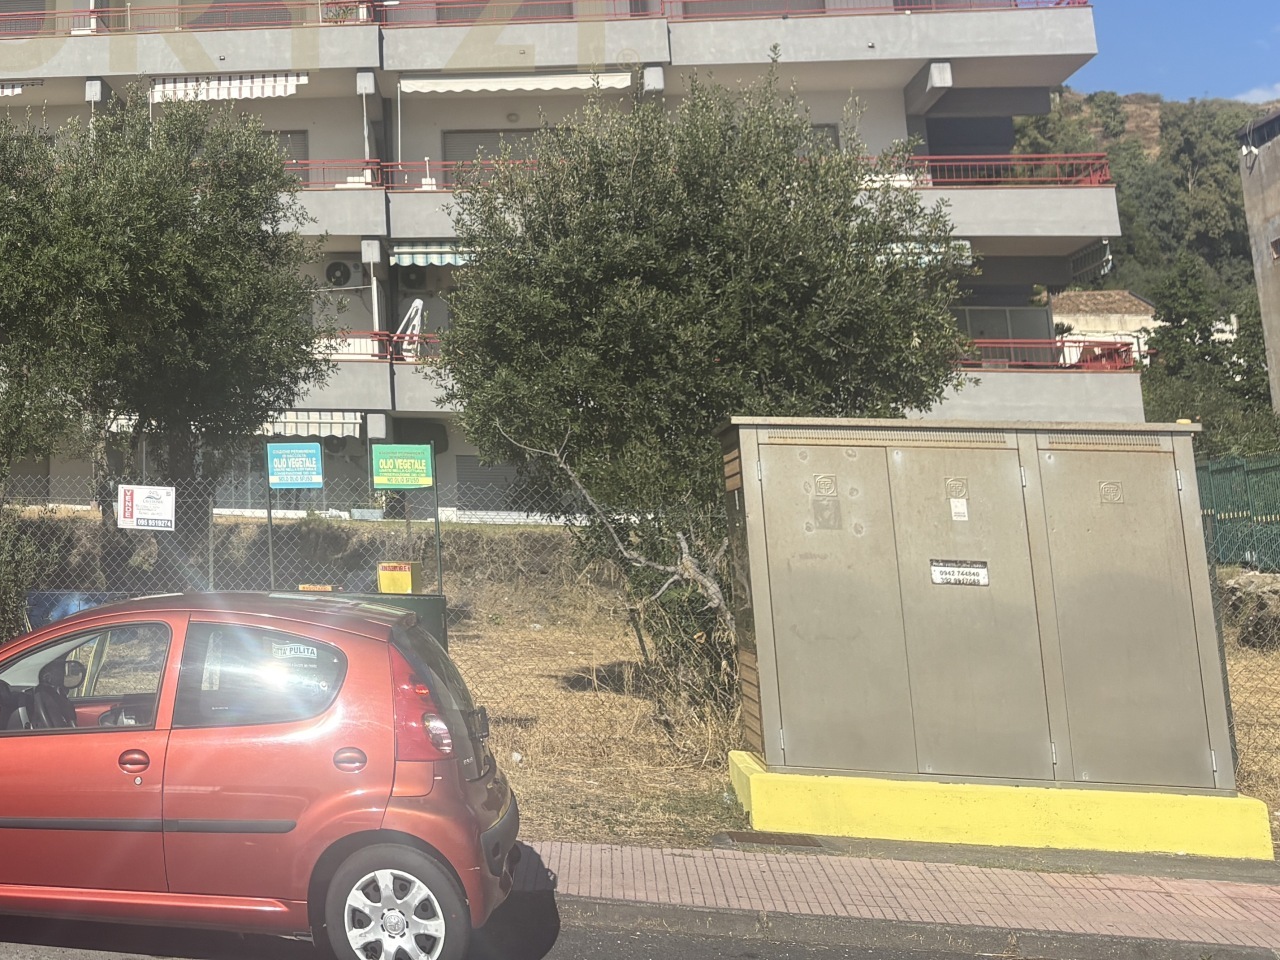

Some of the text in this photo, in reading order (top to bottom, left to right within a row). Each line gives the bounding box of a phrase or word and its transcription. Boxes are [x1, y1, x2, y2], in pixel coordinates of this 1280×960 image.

[273, 458, 316, 468] OLIO VEGETALE
[379, 459, 426, 469] OLIO VEGETALE
[289, 646, 316, 656] PULITA
